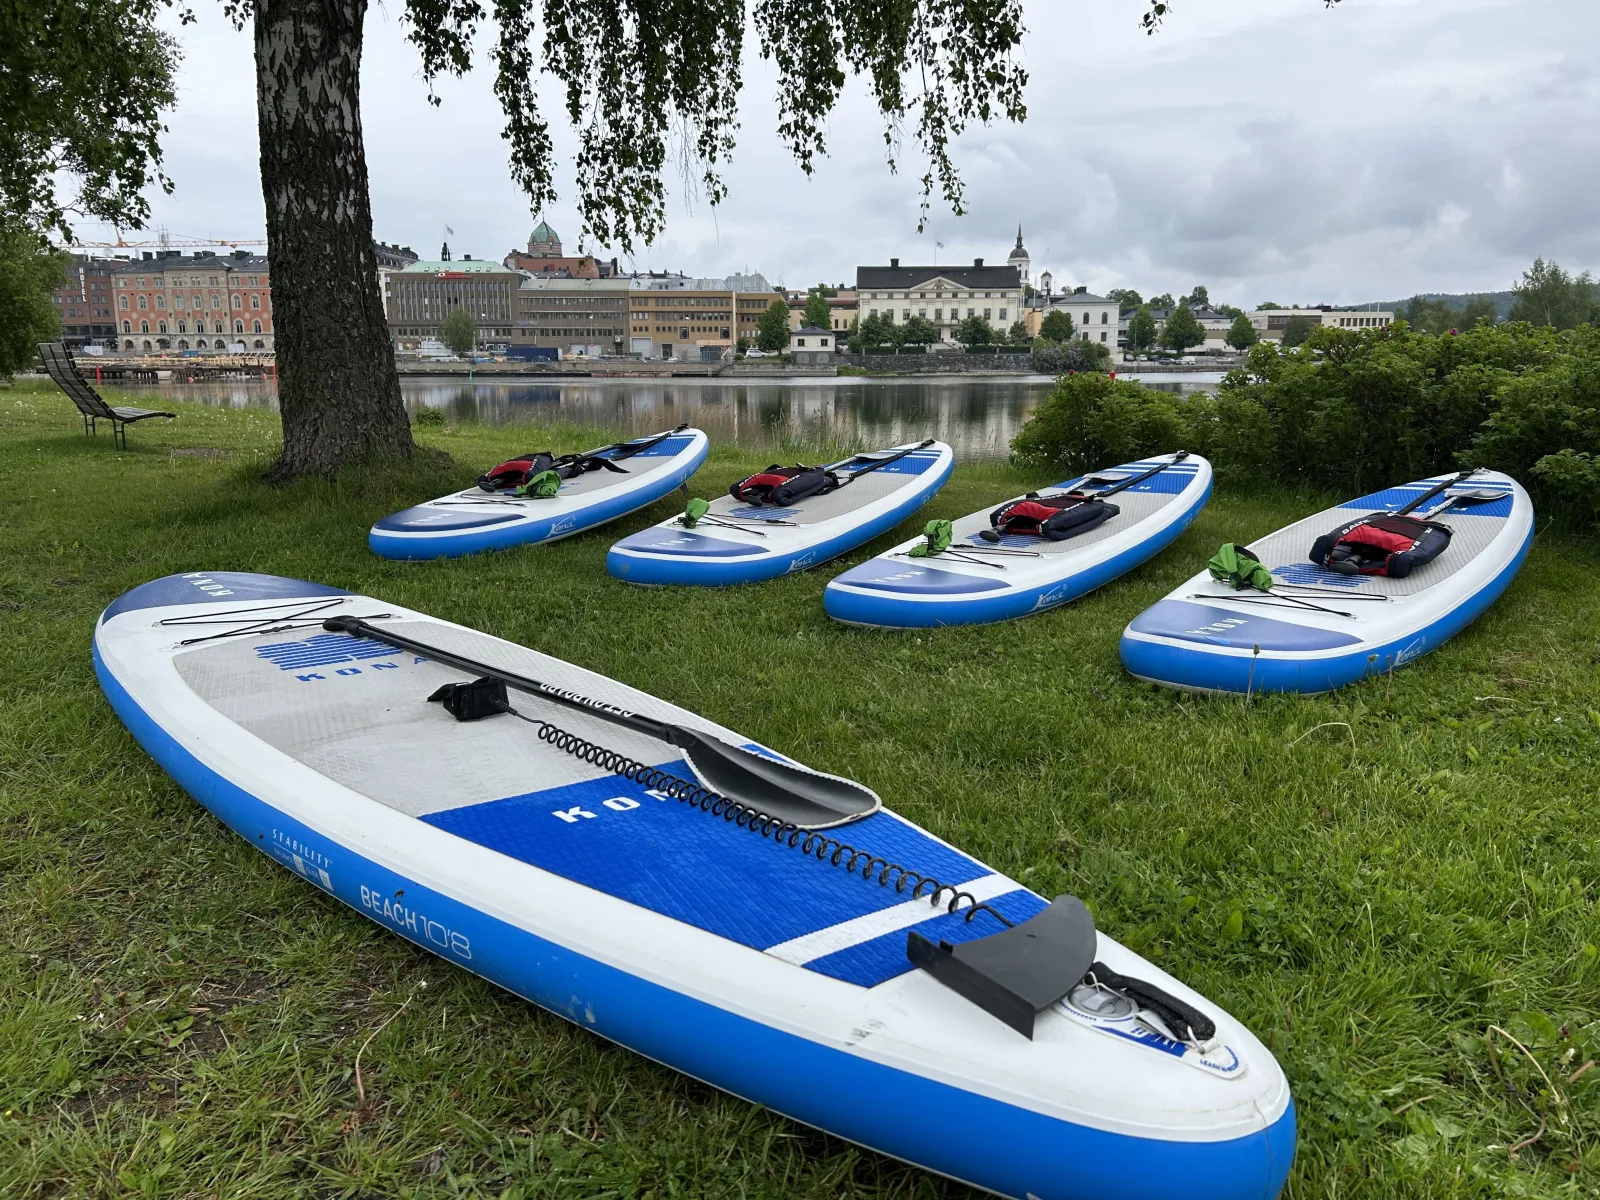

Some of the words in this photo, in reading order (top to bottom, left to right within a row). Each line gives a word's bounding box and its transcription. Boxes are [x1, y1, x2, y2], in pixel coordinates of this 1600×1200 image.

[79, 267, 87, 302] HOTEL
[182, 572, 235, 597] KONA
[294, 656, 431, 682] KONA
[272, 828, 330, 869] STABILITY
[360, 884, 418, 934] BEACH
